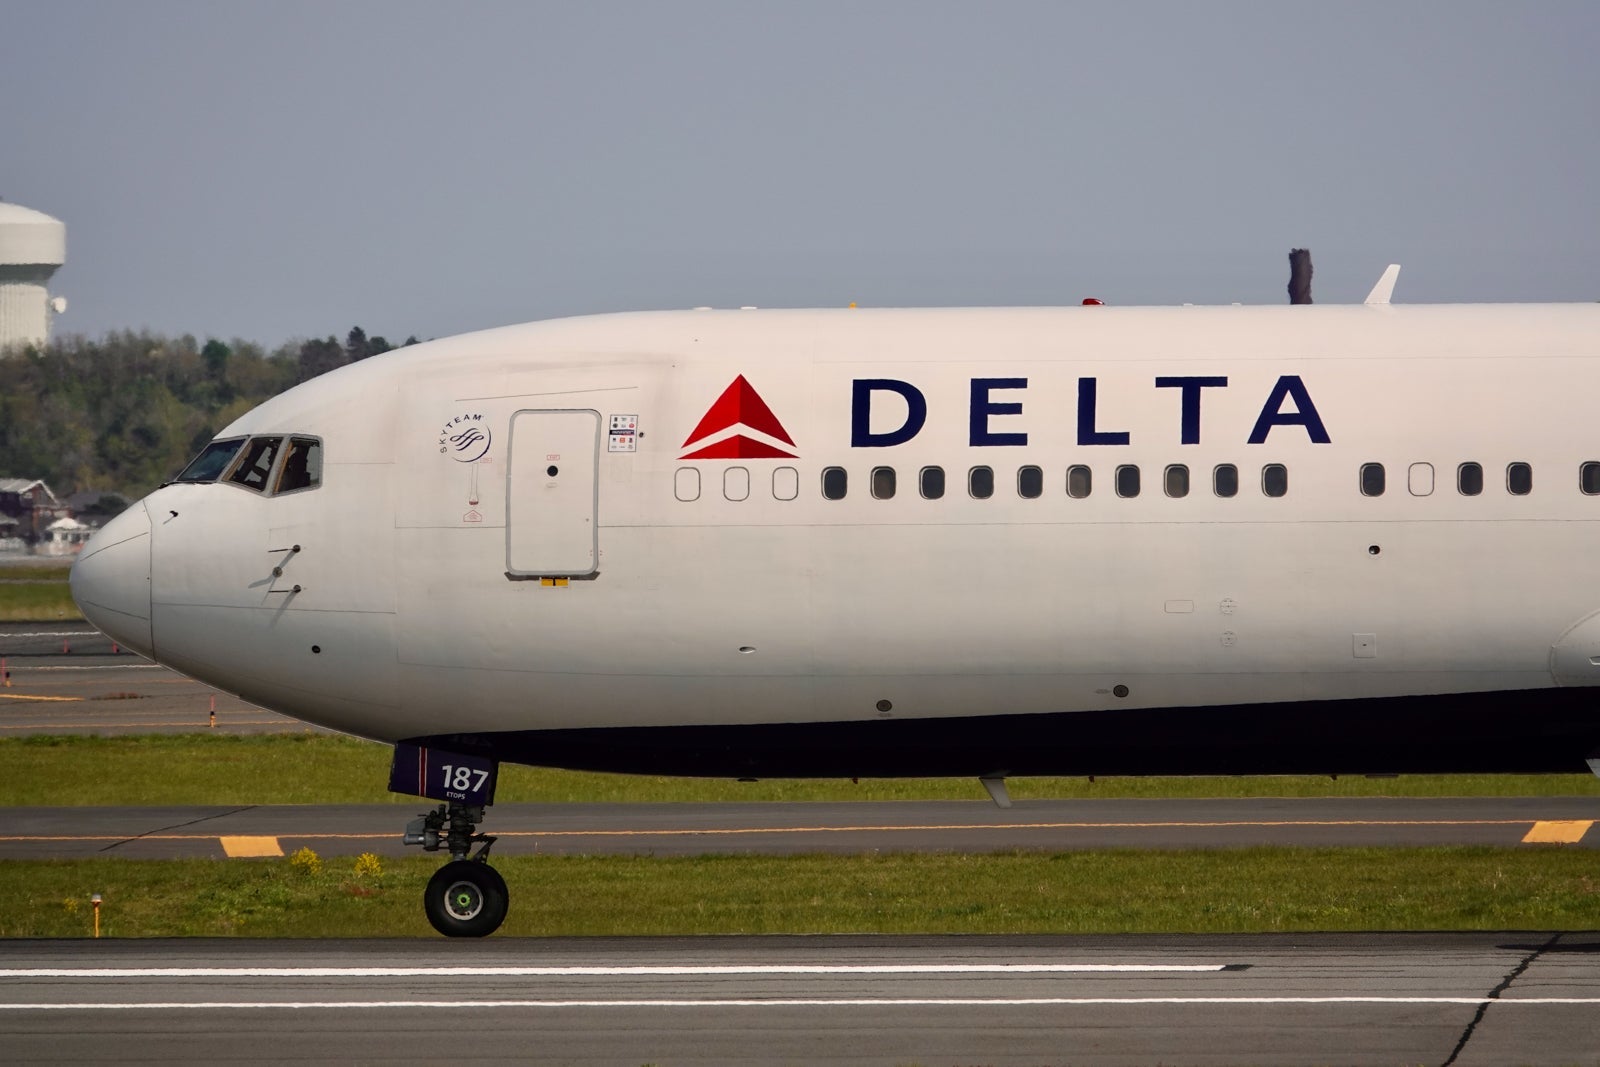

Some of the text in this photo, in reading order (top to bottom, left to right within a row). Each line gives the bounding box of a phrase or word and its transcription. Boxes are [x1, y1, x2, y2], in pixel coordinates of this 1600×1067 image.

[851, 376, 1331, 447] DELTA
[439, 414, 482, 454] SKYTEAM
[442, 764, 489, 793] 187
[446, 791, 466, 800] ETOPS
